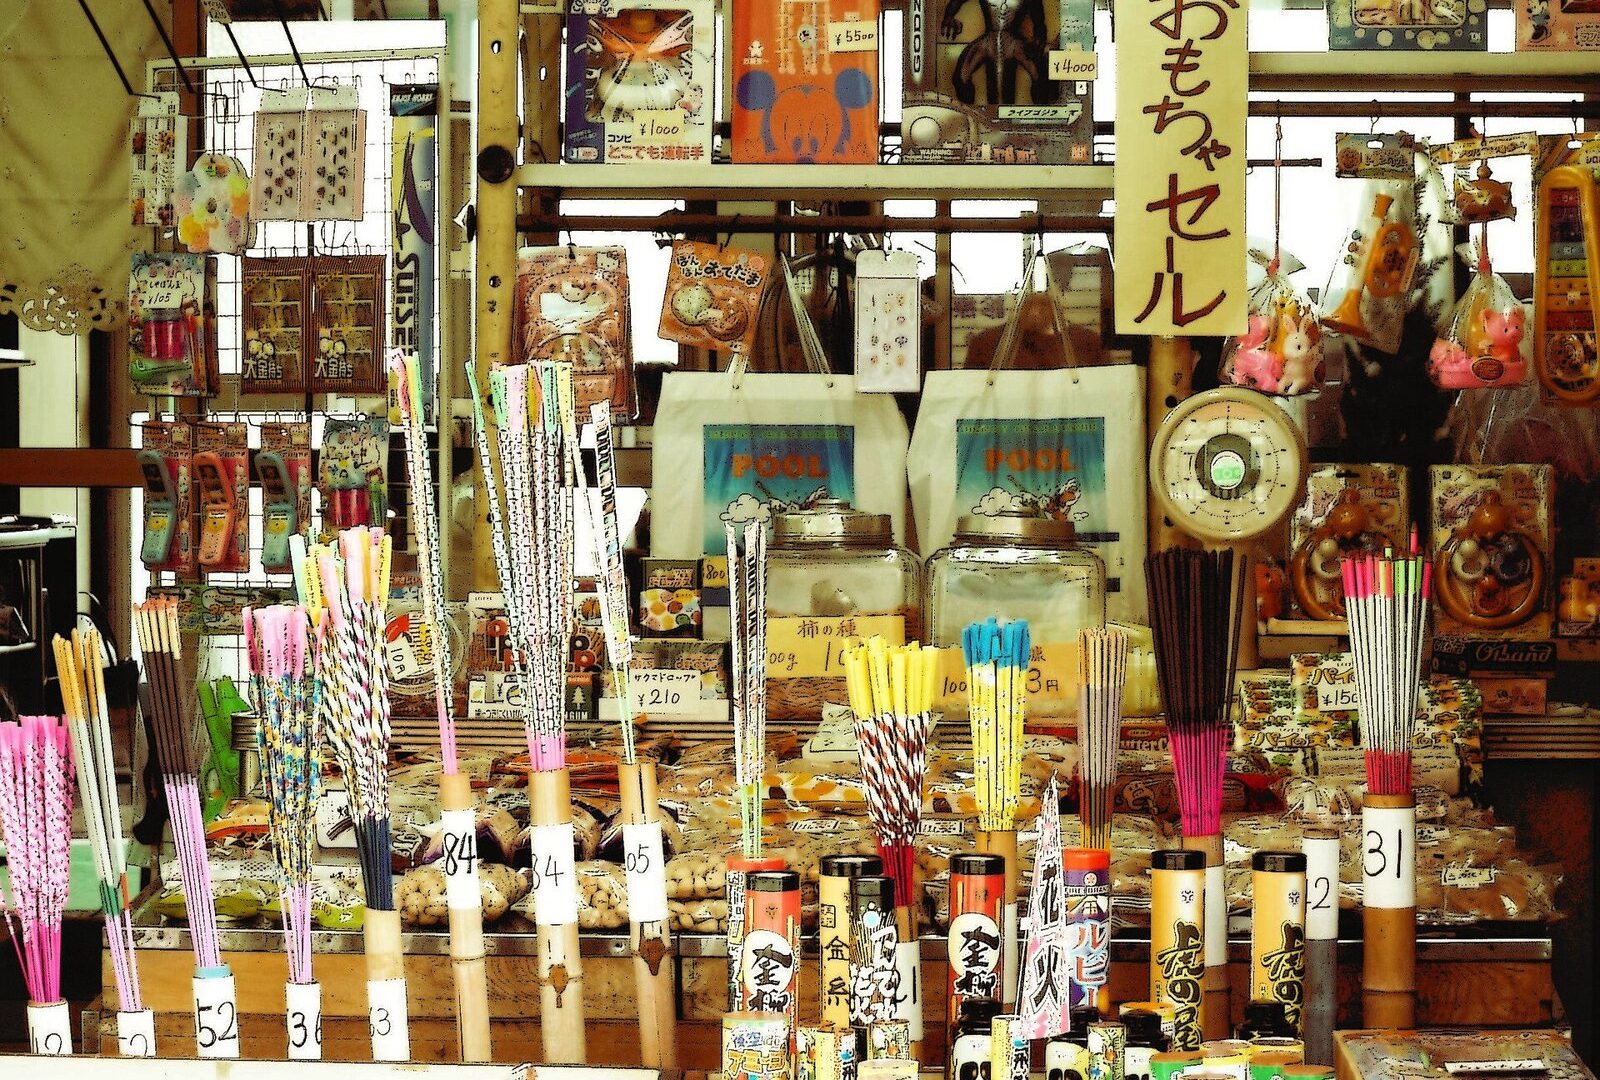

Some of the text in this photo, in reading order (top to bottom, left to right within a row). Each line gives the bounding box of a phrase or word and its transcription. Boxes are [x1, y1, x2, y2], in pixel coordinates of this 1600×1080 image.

[835, 29, 874, 46] ¥5500
[1053, 57, 1095, 73] ¥4000
[640, 119, 679, 136] ¥1000
[1133, 0, 1239, 327] おもちゃセール
[732, 453, 829, 480] POOL
[984, 447, 1077, 473] POOL
[637, 688, 681, 707] ¥210
[443, 832, 476, 876] 84
[1363, 828, 1402, 879] 31
[197, 998, 237, 1048] 52
